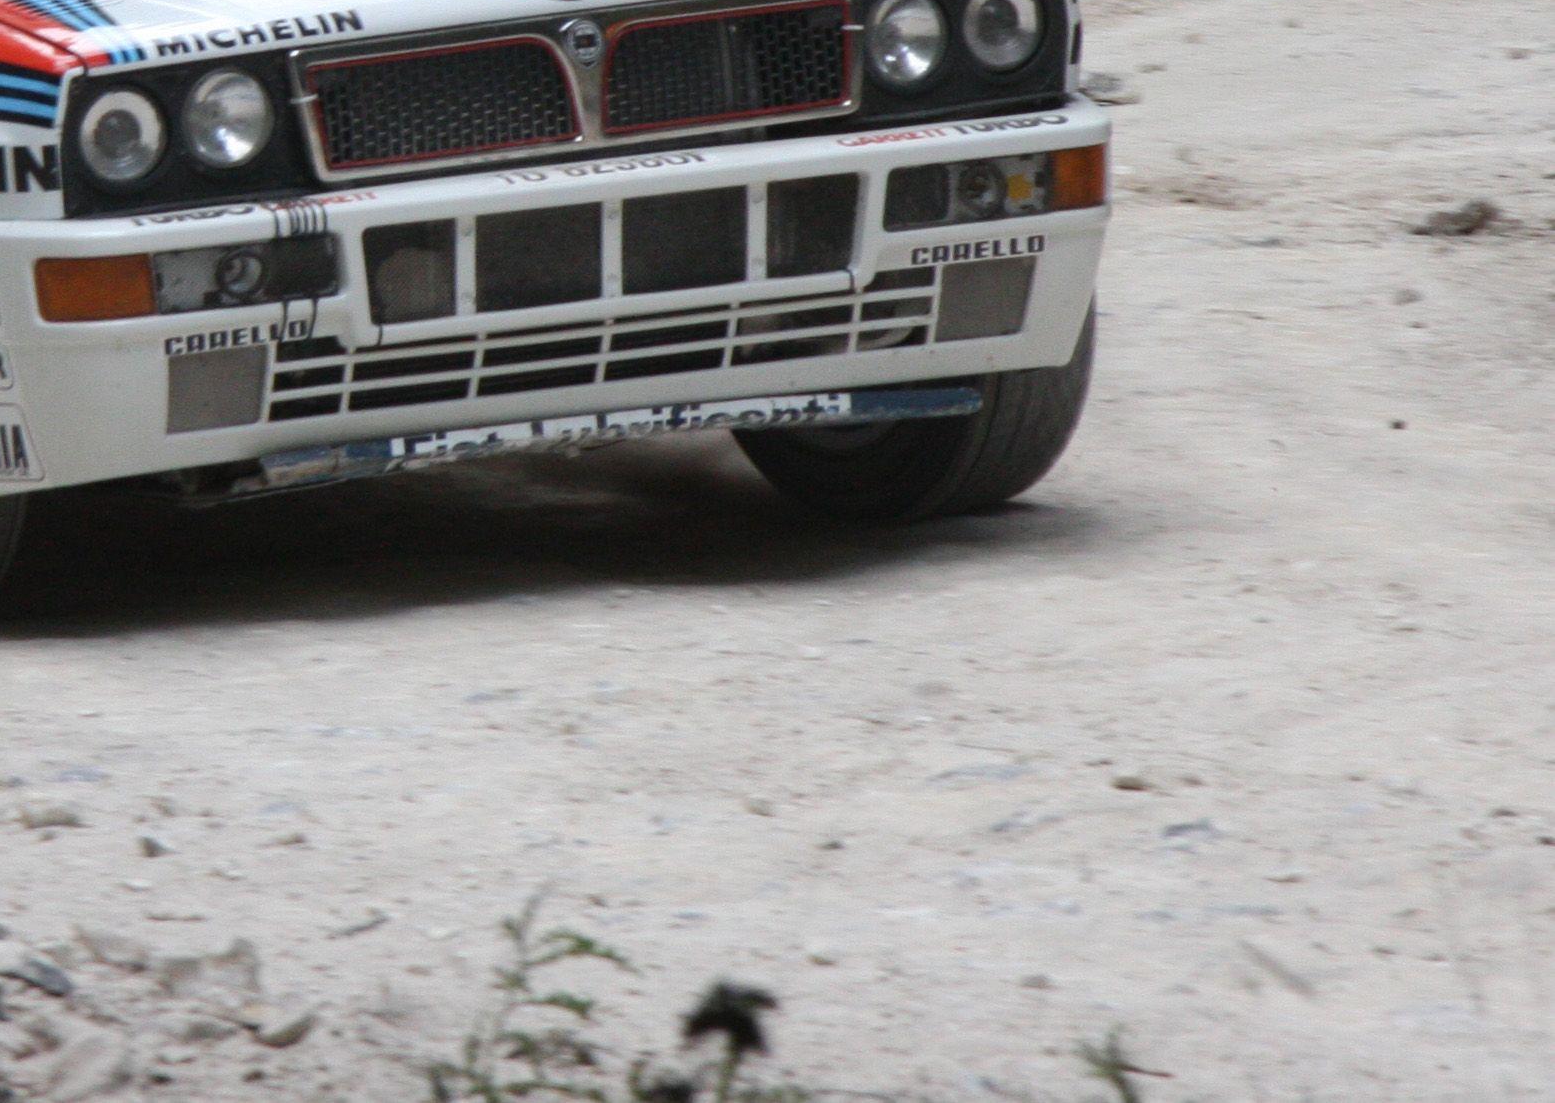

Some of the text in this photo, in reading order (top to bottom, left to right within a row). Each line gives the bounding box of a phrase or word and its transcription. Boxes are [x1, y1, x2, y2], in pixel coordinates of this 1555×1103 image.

[152, 9, 364, 56] MICHELIN
[911, 234, 1045, 265] CARELLO
[164, 320, 309, 355] CARELLO
